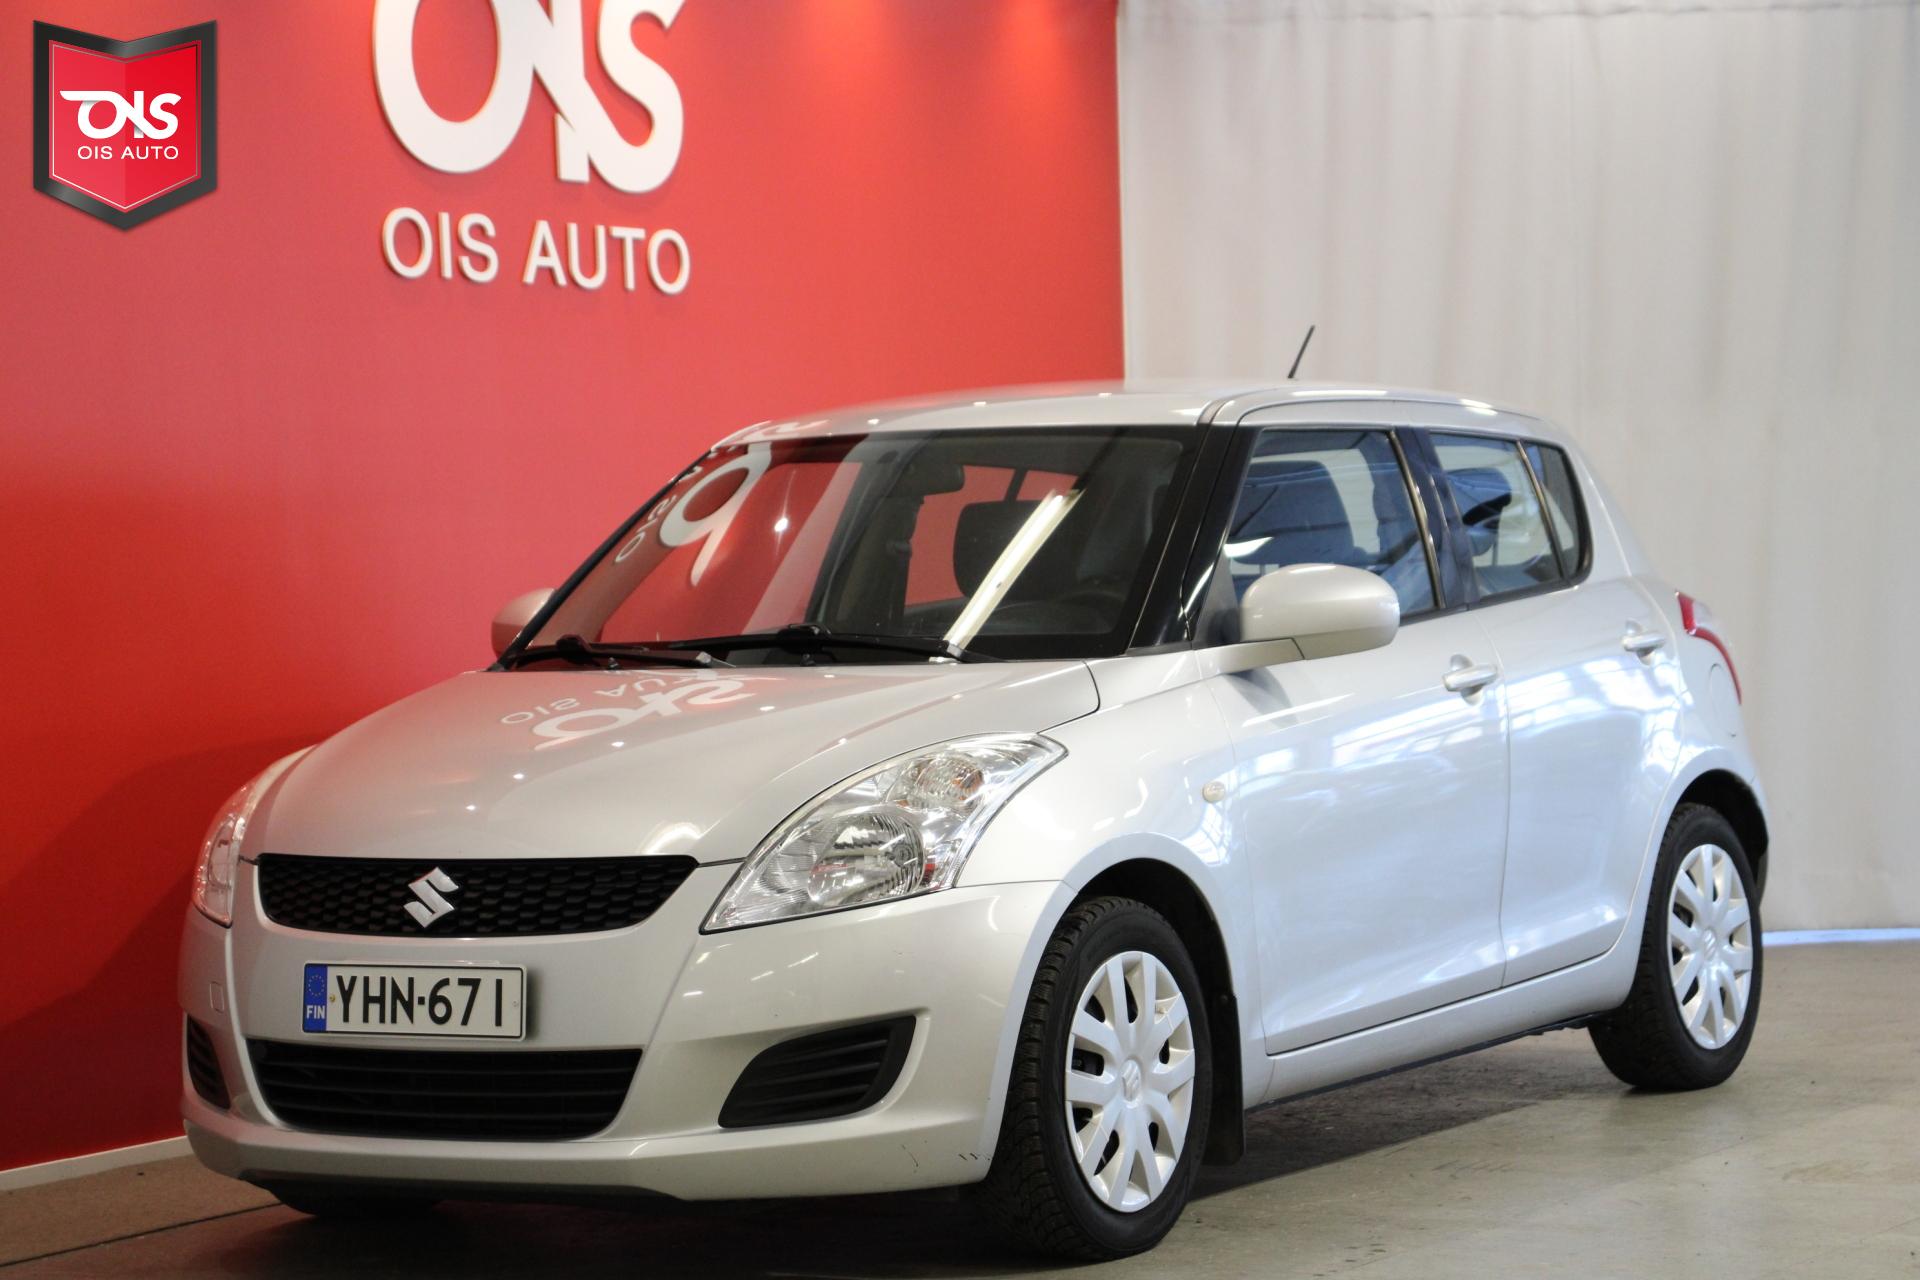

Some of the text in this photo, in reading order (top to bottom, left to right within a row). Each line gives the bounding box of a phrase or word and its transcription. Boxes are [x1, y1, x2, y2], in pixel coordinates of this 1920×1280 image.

[382, 206, 691, 295] OIS AUTO
[305, 1004, 326, 1020] FIN
[335, 974, 503, 1027] YHN-671
